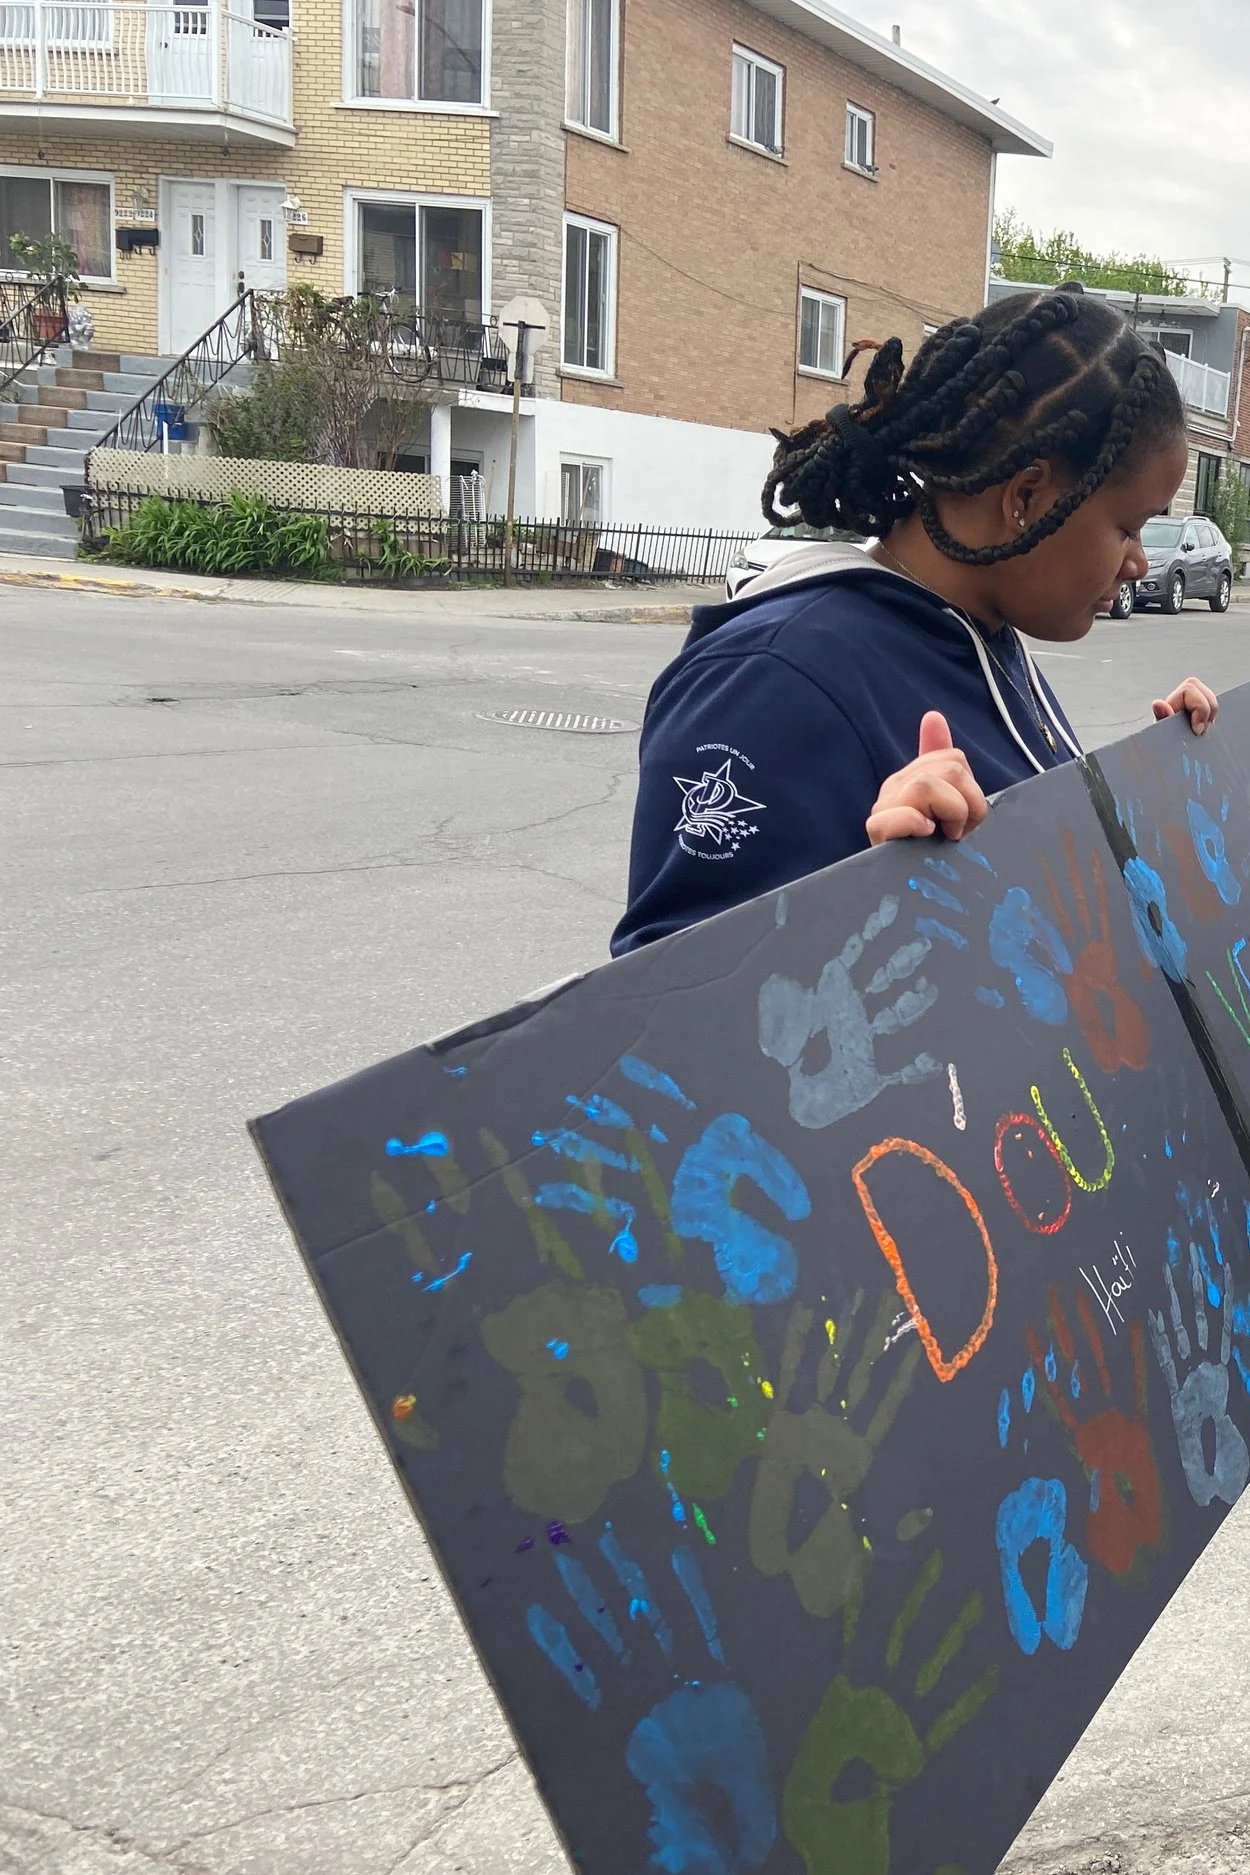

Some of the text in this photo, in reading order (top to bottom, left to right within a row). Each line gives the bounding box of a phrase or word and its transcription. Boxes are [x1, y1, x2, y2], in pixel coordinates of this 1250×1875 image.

[696, 743, 756, 771] PATRIOTES UN JOUR
[697, 851, 735, 861] TOUJOURS
